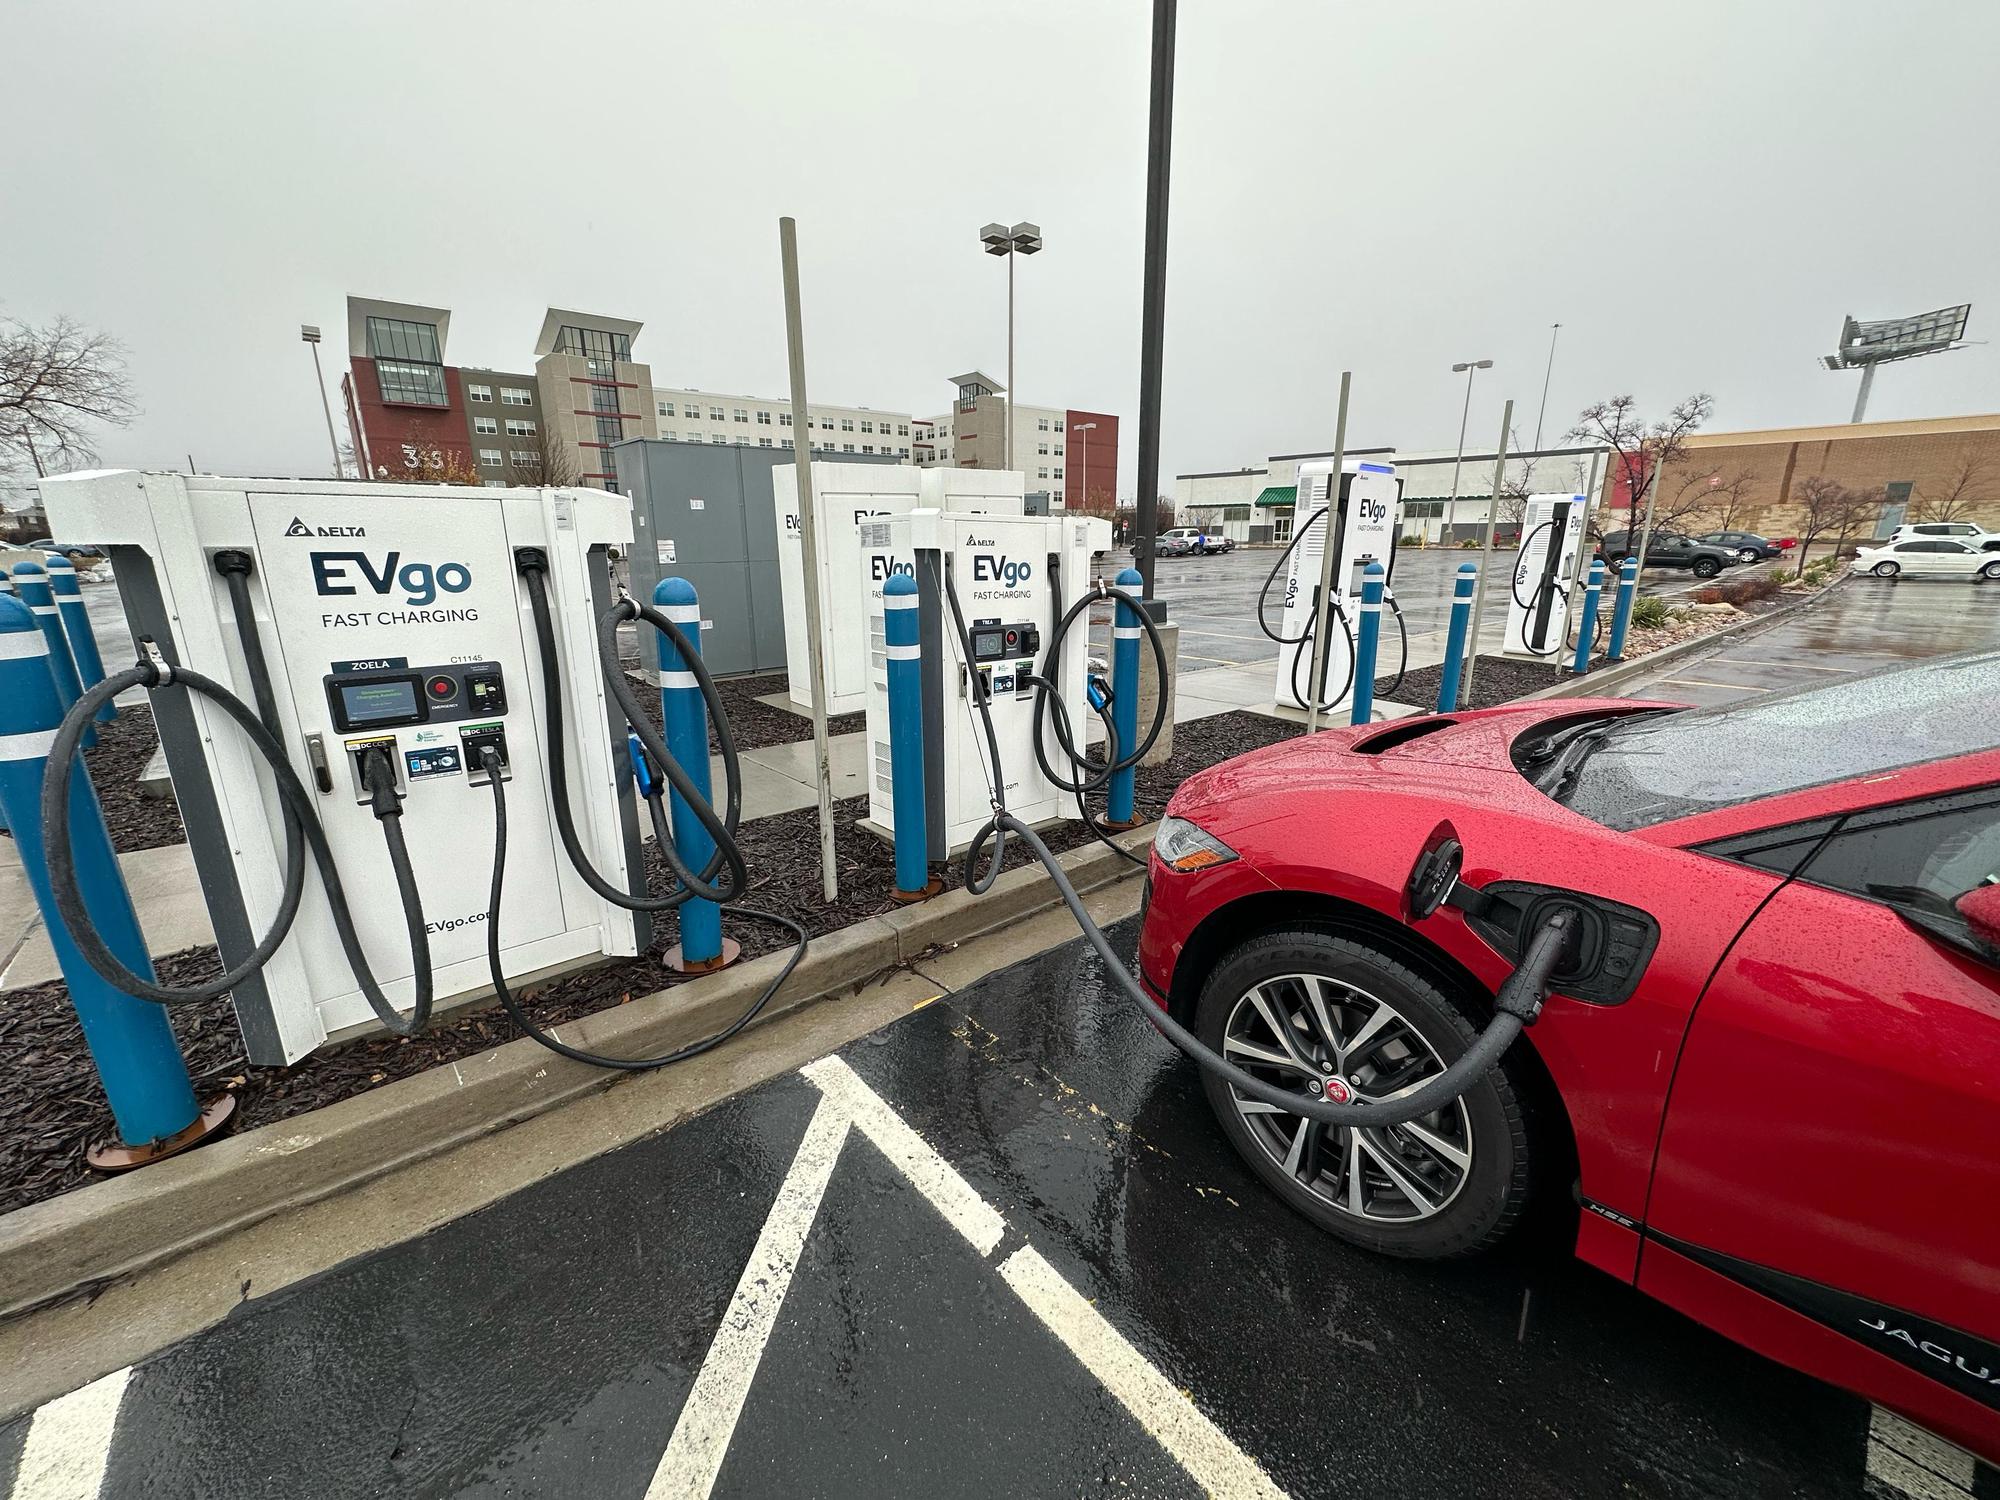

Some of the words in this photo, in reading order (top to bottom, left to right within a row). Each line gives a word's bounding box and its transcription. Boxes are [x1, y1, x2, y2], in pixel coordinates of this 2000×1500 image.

[1360, 499, 1386, 523] EVgo
[317, 527, 366, 537] DELTA
[786, 515, 801, 533] EVg
[309, 552, 472, 606] EVgo
[974, 555, 1031, 588] EVgo
[1516, 565, 1528, 585] EVgo
[973, 591, 992, 600] FAST
[993, 590, 1031, 600] CHARGING
[1285, 578, 1298, 608] EVgo
[322, 612, 372, 627] FAST
[377, 608, 479, 625] CHARGING
[352, 660, 390, 670] ZOELA
[450, 655, 483, 664] C11145
[1590, 1204, 1634, 1227] HSE
